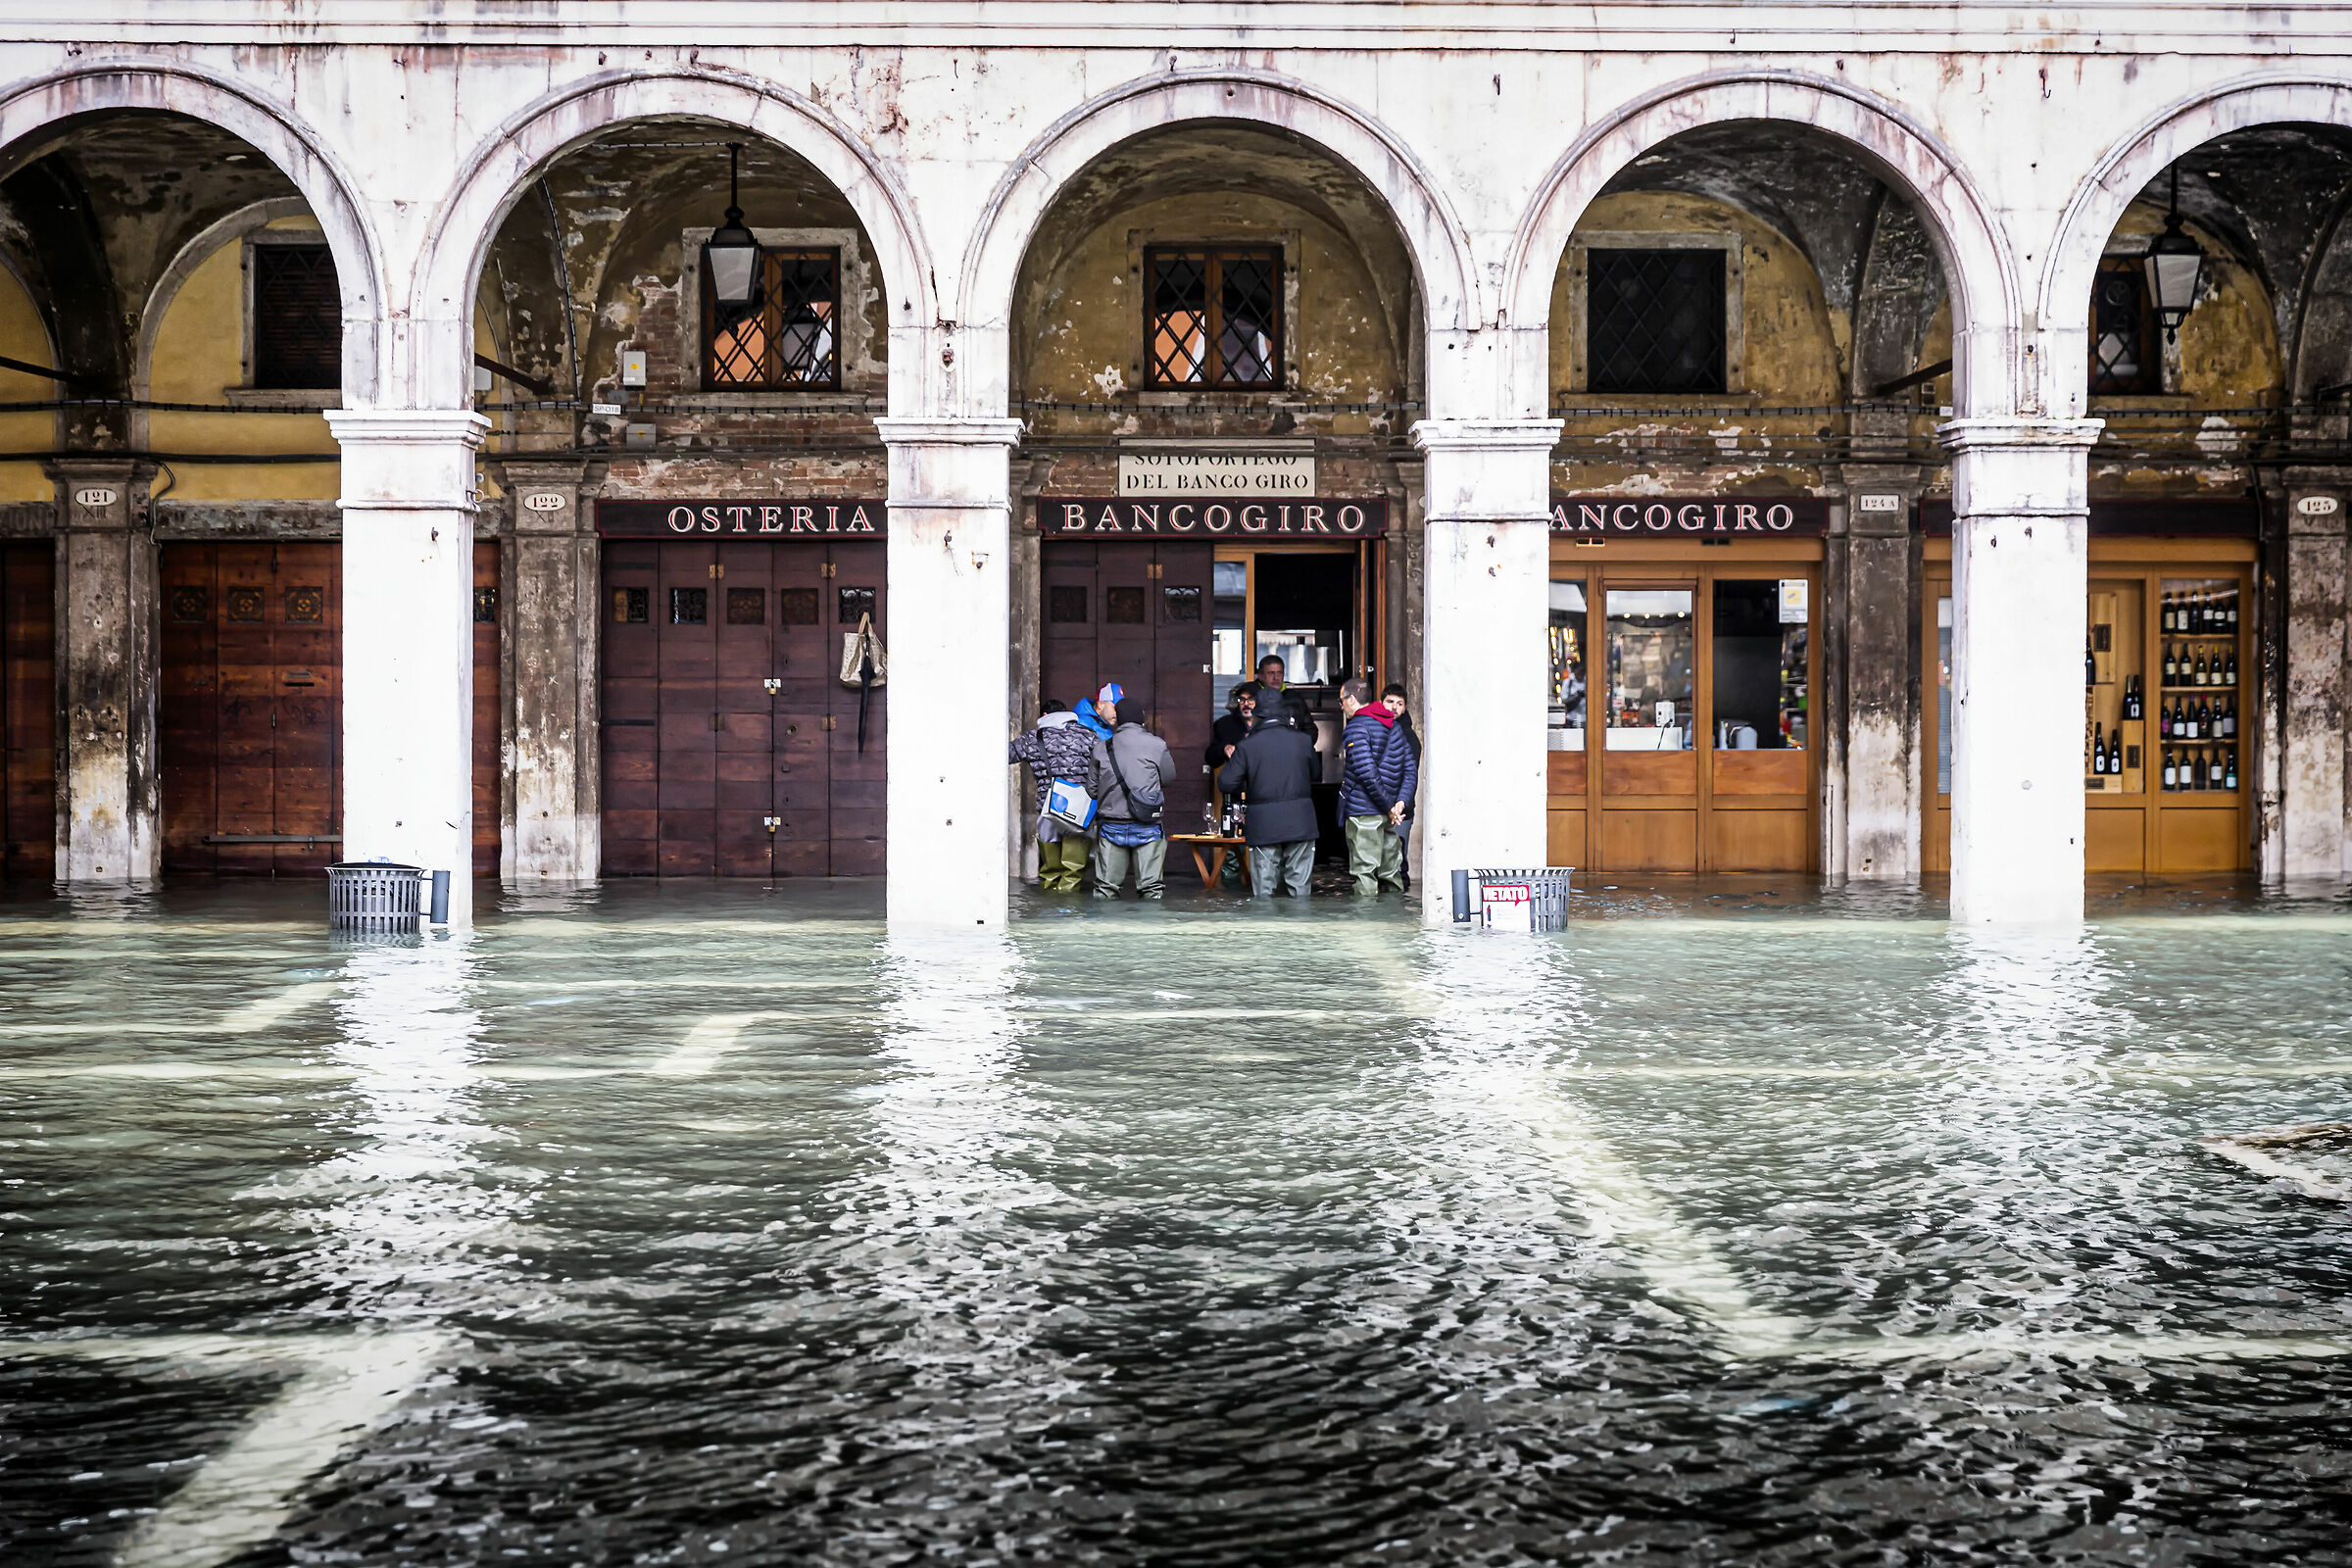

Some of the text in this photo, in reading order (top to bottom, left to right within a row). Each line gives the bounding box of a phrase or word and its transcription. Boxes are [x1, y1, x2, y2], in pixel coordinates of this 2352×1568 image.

[1127, 474, 1308, 489] DEL BANCO GIRO
[84, 491, 108, 503] 121
[533, 496, 558, 508] 122
[2307, 501, 2331, 512] 125
[667, 506, 875, 533] OSTERIA
[1061, 504, 1366, 532] BANCOGIRO
[1549, 504, 1794, 530] ANCOGIRO
